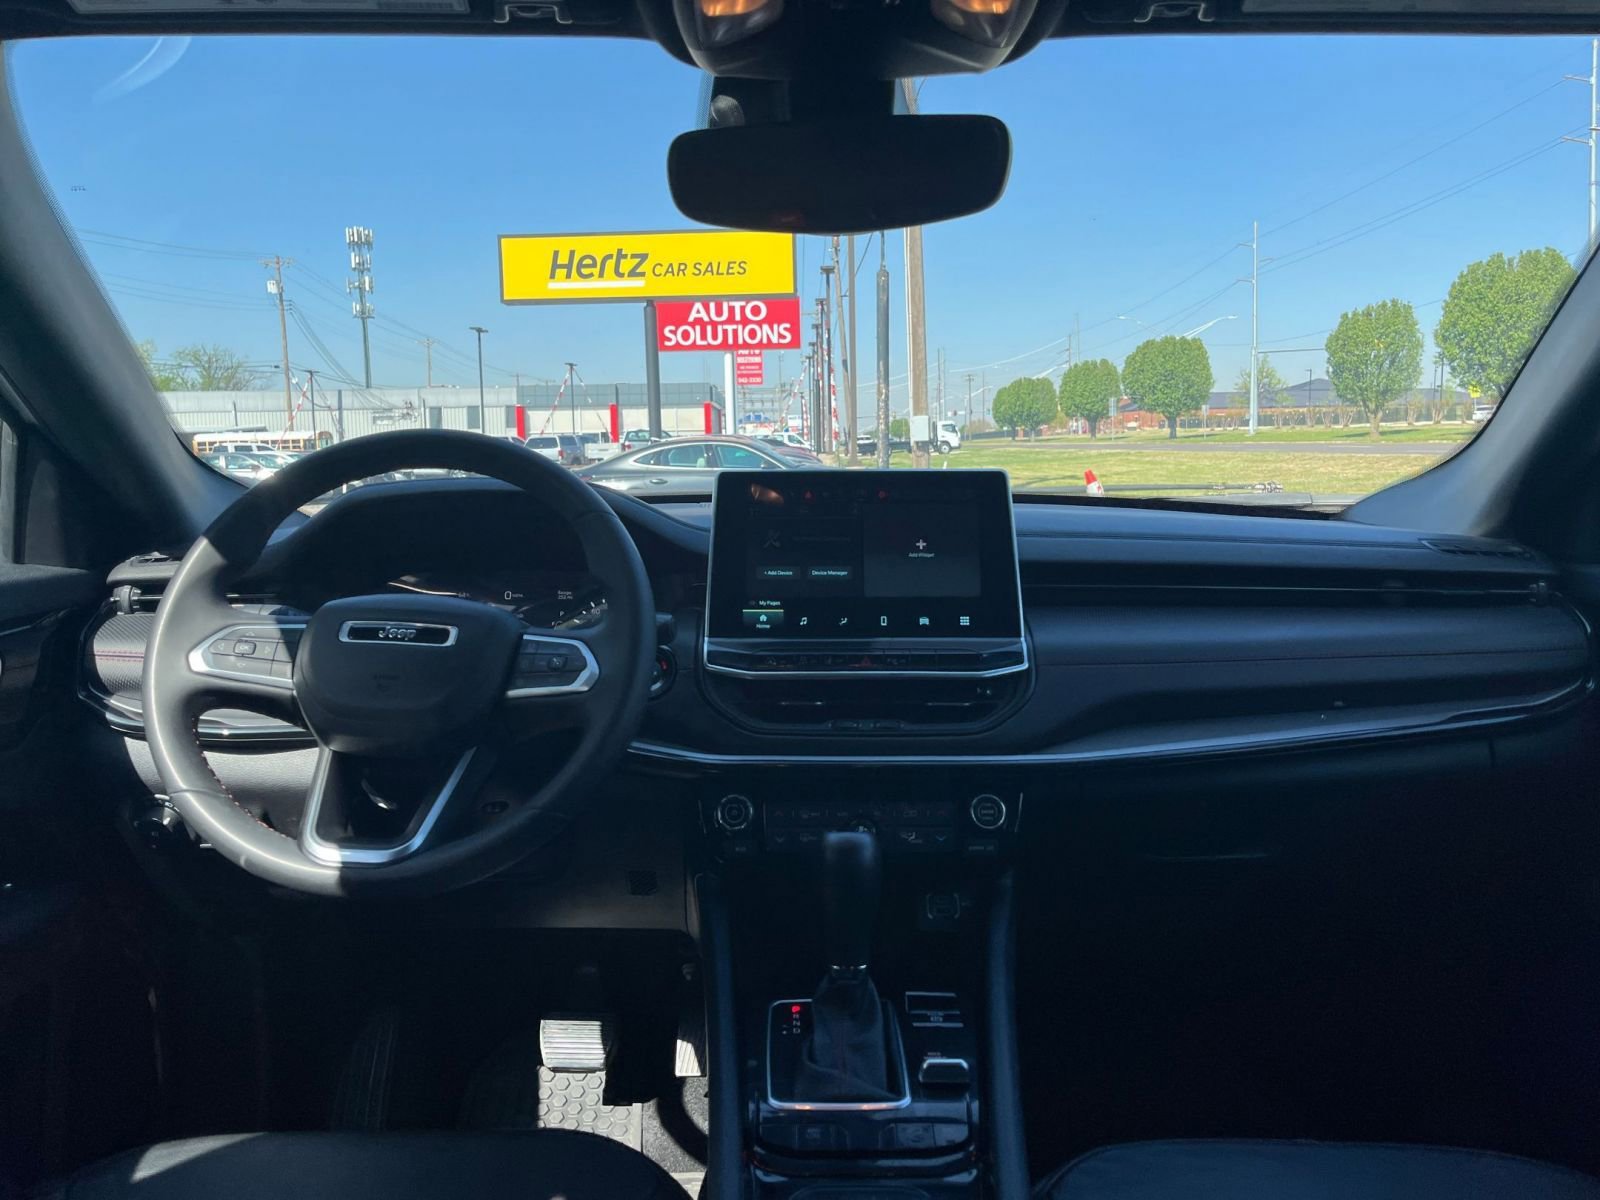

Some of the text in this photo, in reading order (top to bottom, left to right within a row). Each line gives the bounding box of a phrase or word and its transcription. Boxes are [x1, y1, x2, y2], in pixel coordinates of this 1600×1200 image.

[549, 248, 748, 280] Hertz CAR SALES
[688, 300, 767, 322] AUTO
[663, 323, 792, 346] SOLUTIONS
[378, 626, 417, 640] Jeep
